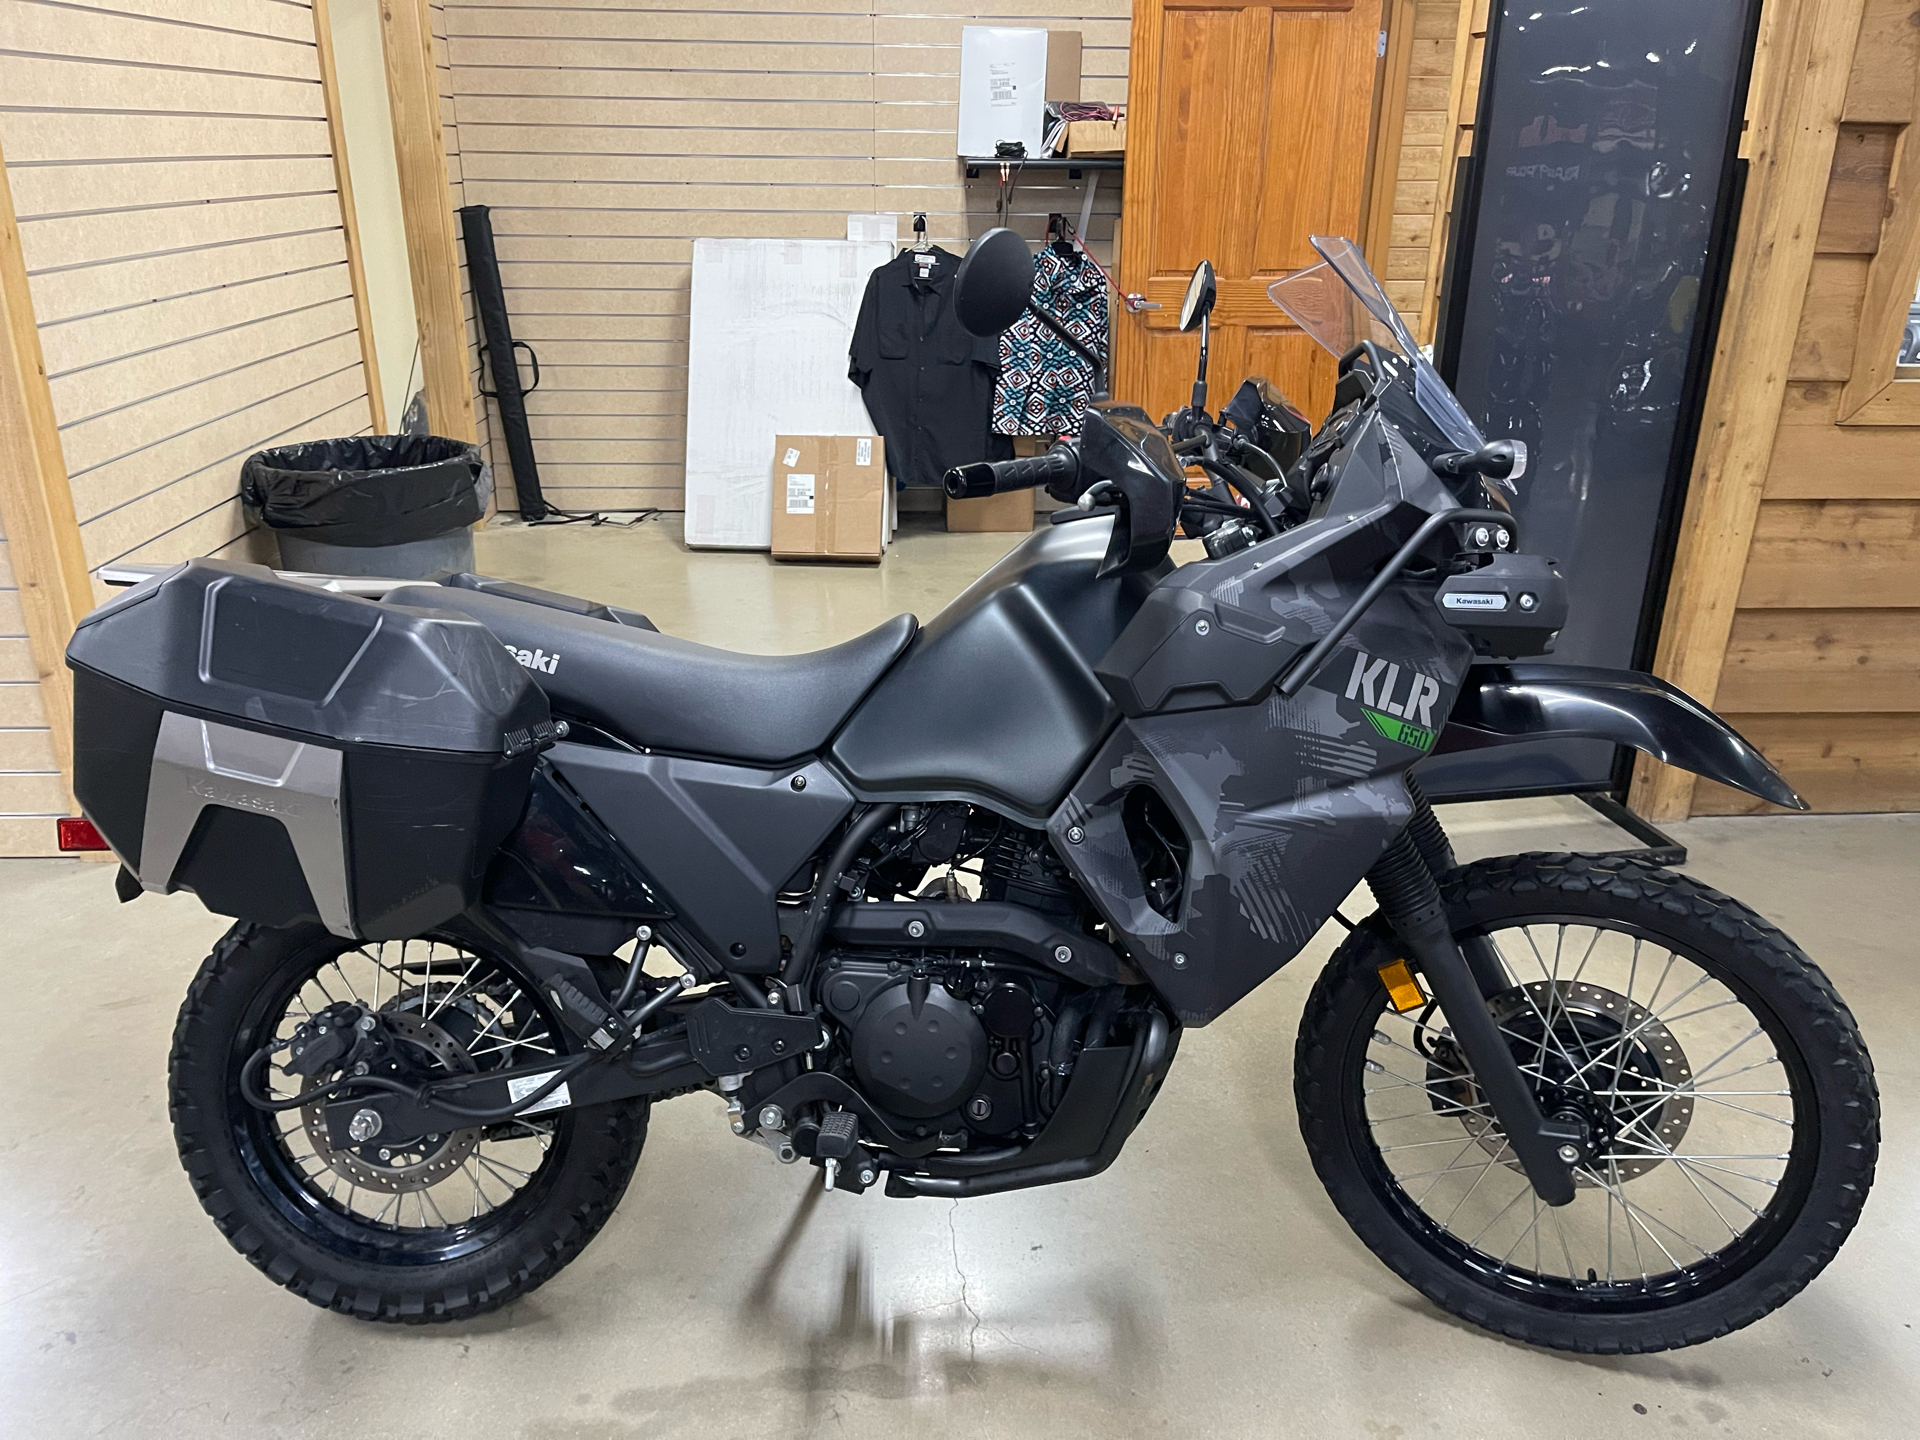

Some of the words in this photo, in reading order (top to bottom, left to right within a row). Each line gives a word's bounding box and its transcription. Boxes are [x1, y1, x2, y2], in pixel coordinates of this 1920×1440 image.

[1456, 597, 1494, 606] Kawasaki
[1345, 651, 1439, 727] KLR
[1397, 723, 1430, 750] 650
